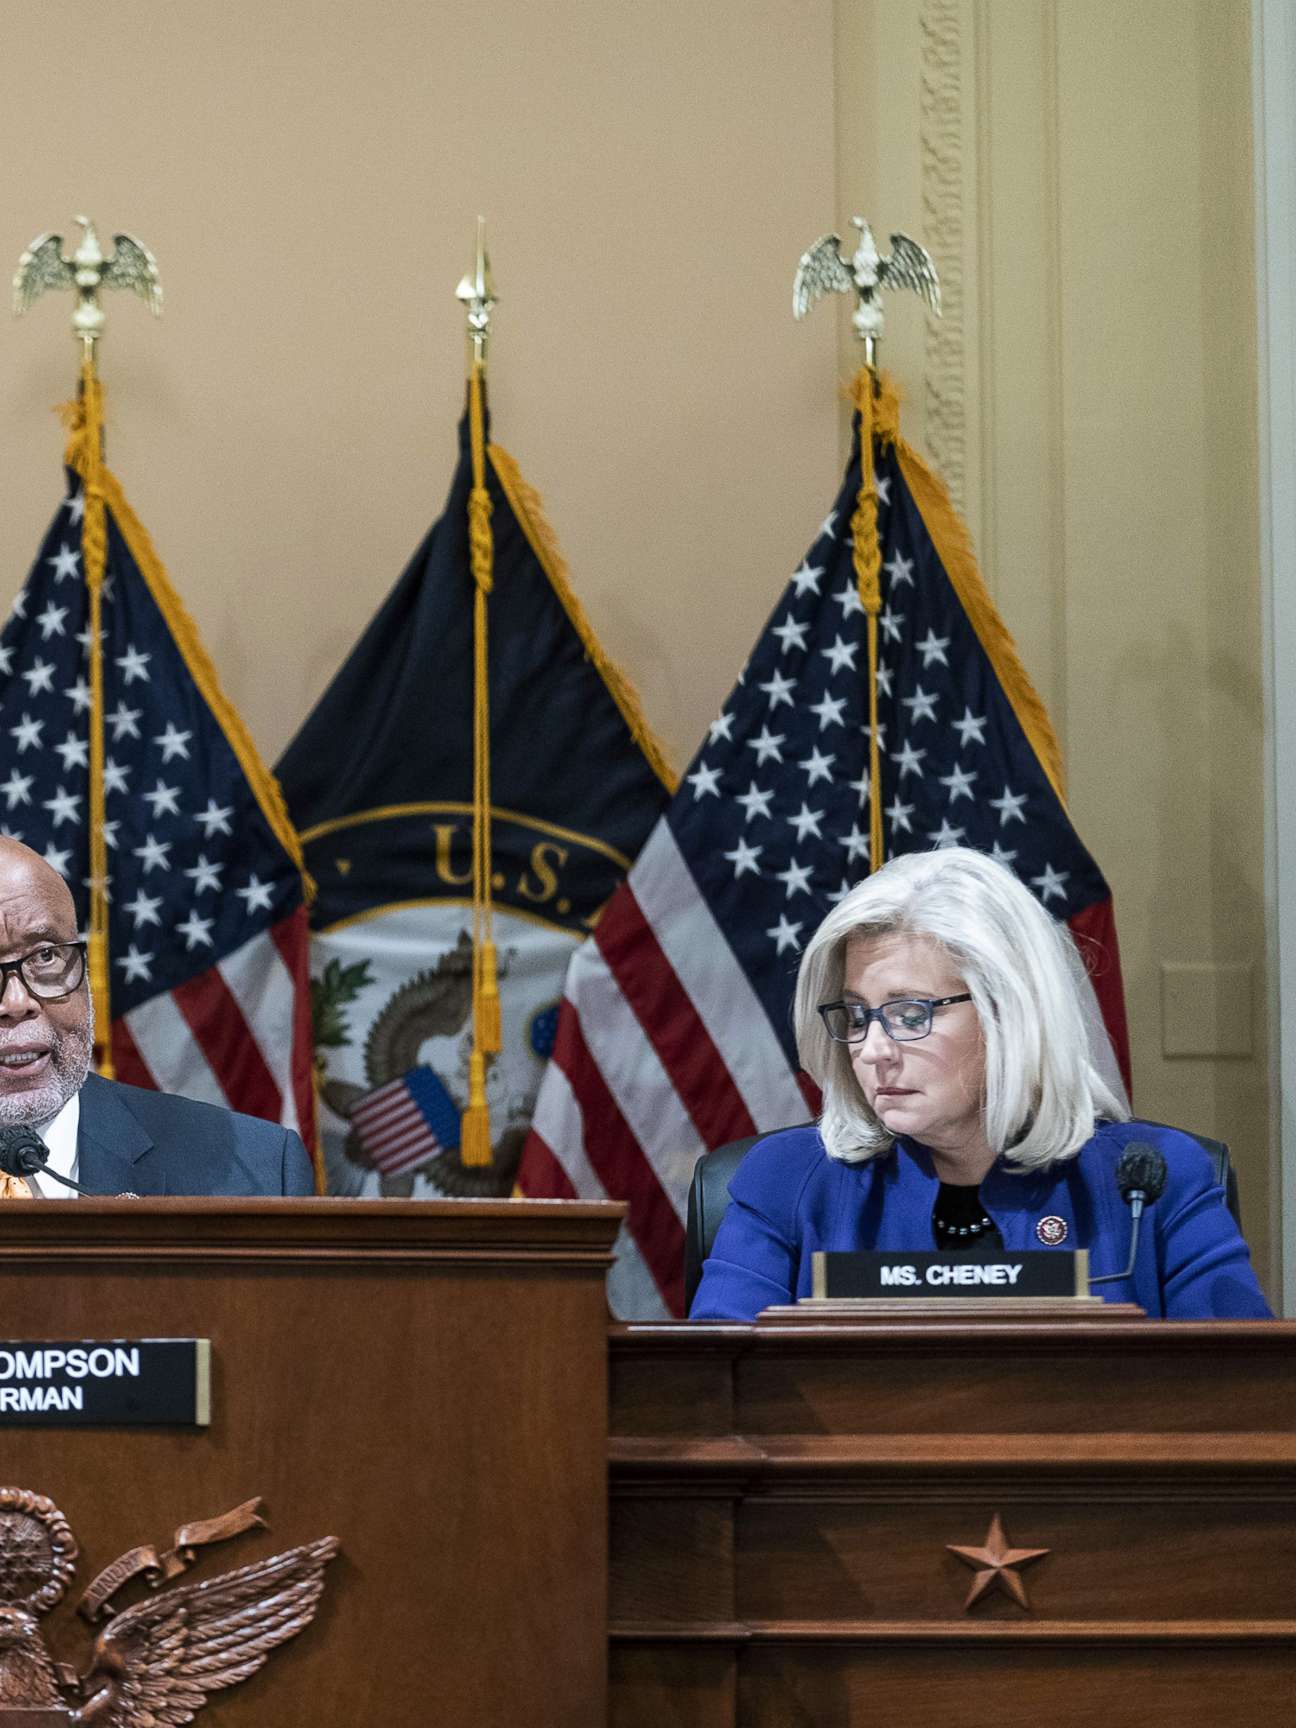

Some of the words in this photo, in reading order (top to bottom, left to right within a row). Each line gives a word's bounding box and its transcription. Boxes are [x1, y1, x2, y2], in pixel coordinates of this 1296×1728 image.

[432, 824, 572, 914] U.S.
[880, 1265, 922, 1286] MS.
[925, 1263, 1023, 1285] CHENEY
